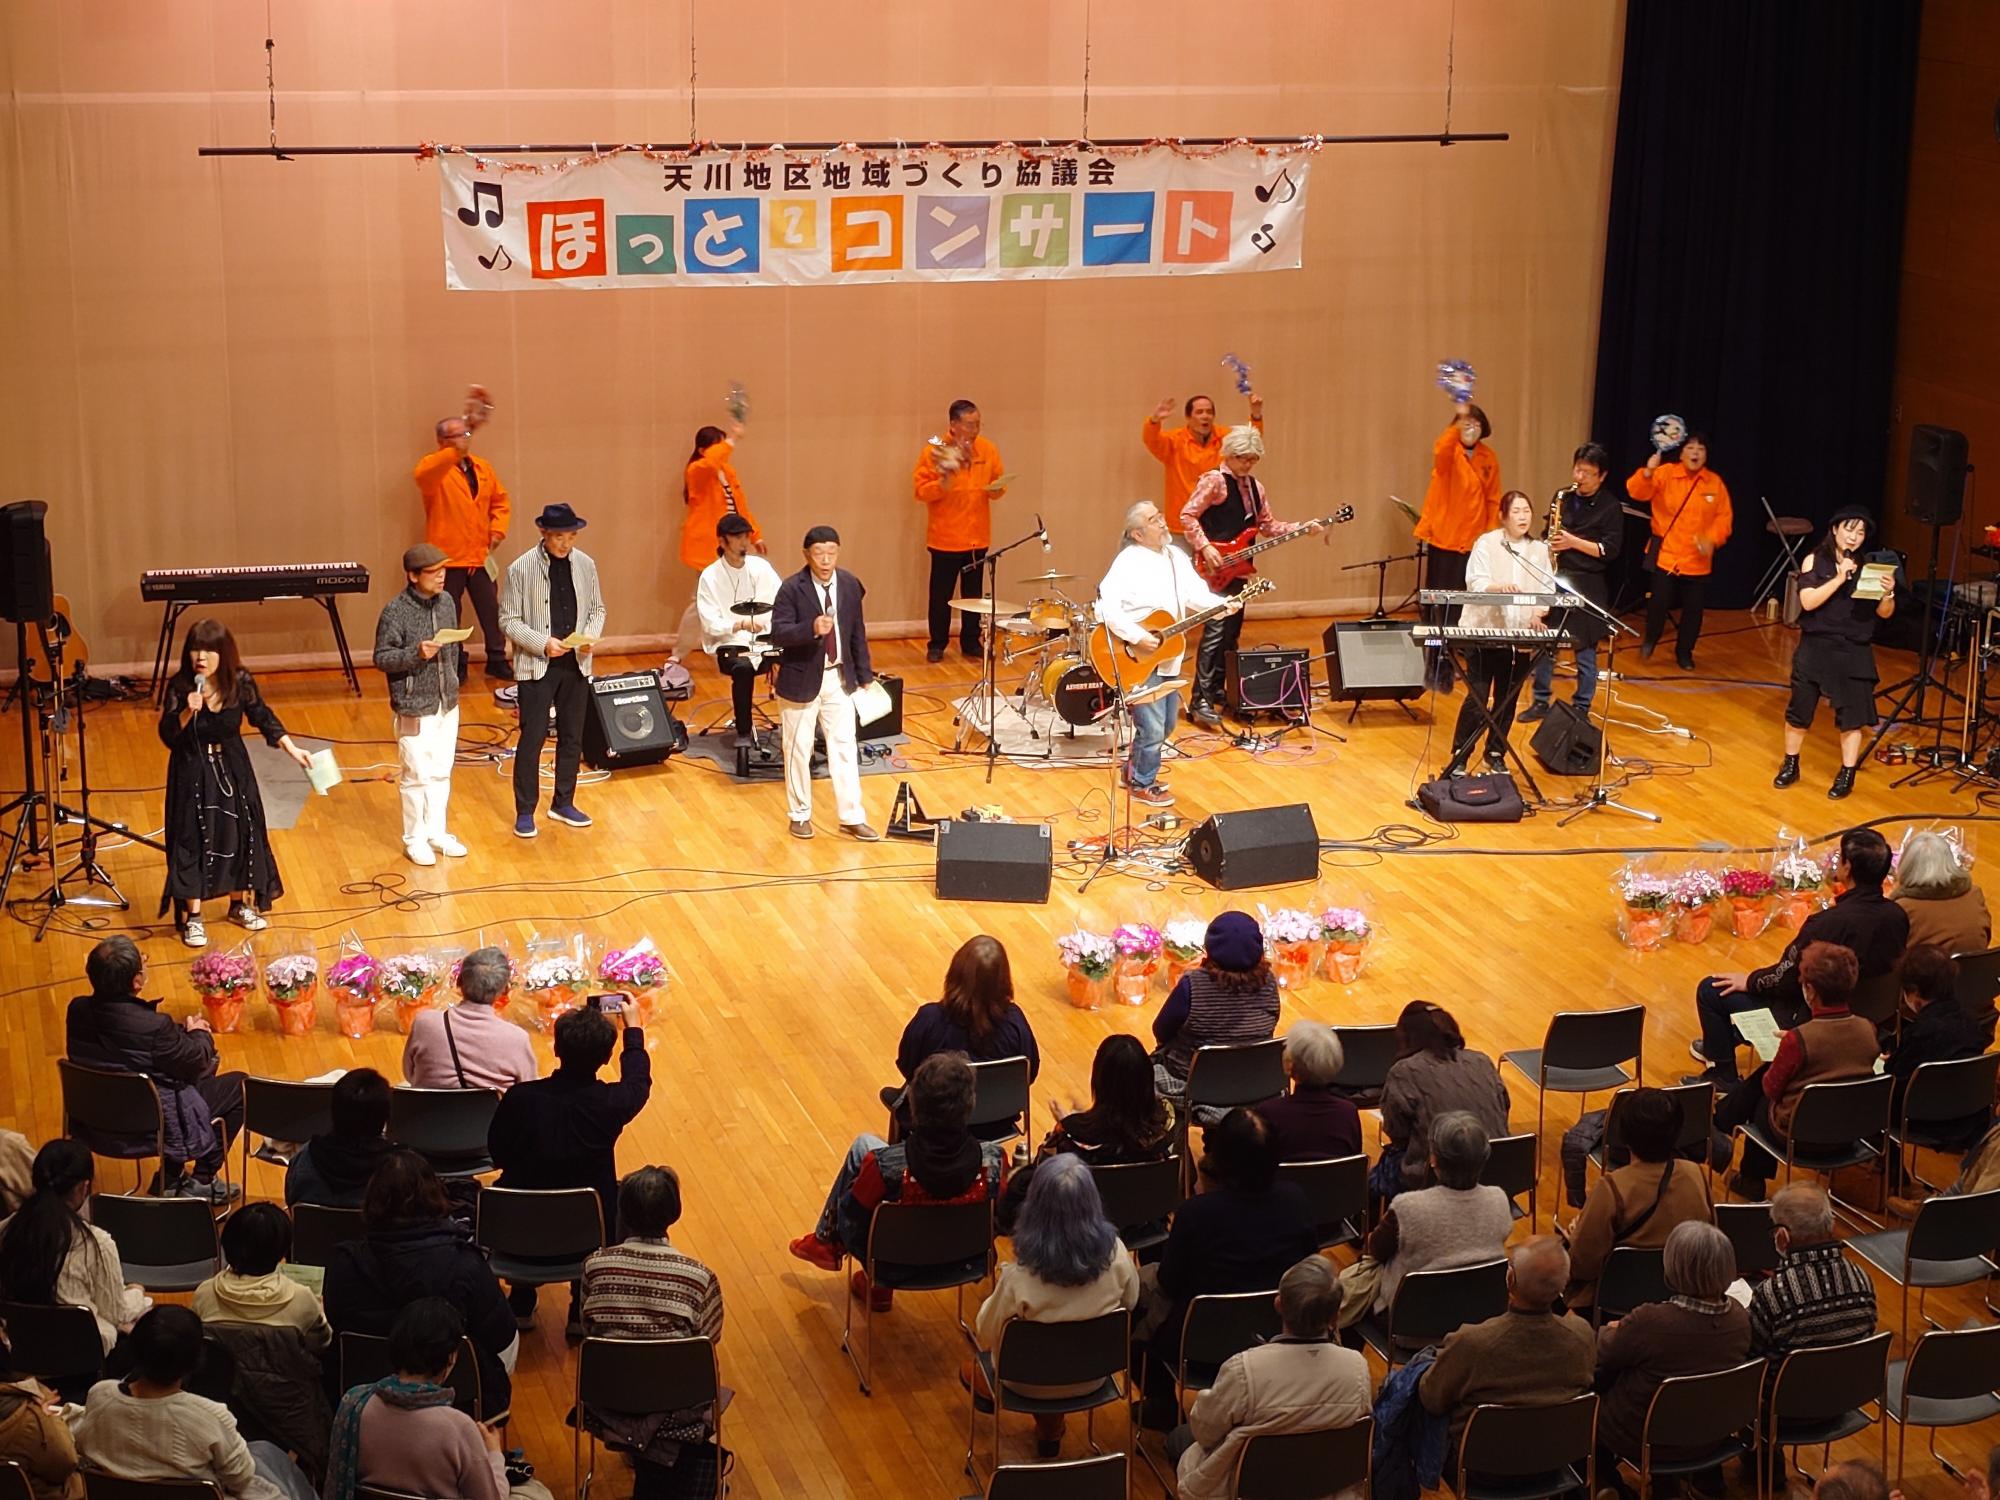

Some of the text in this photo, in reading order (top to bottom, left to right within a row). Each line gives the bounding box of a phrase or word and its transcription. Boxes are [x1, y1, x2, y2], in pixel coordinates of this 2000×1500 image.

[663, 158, 1116, 191] 天川地区地域づくり協議会
